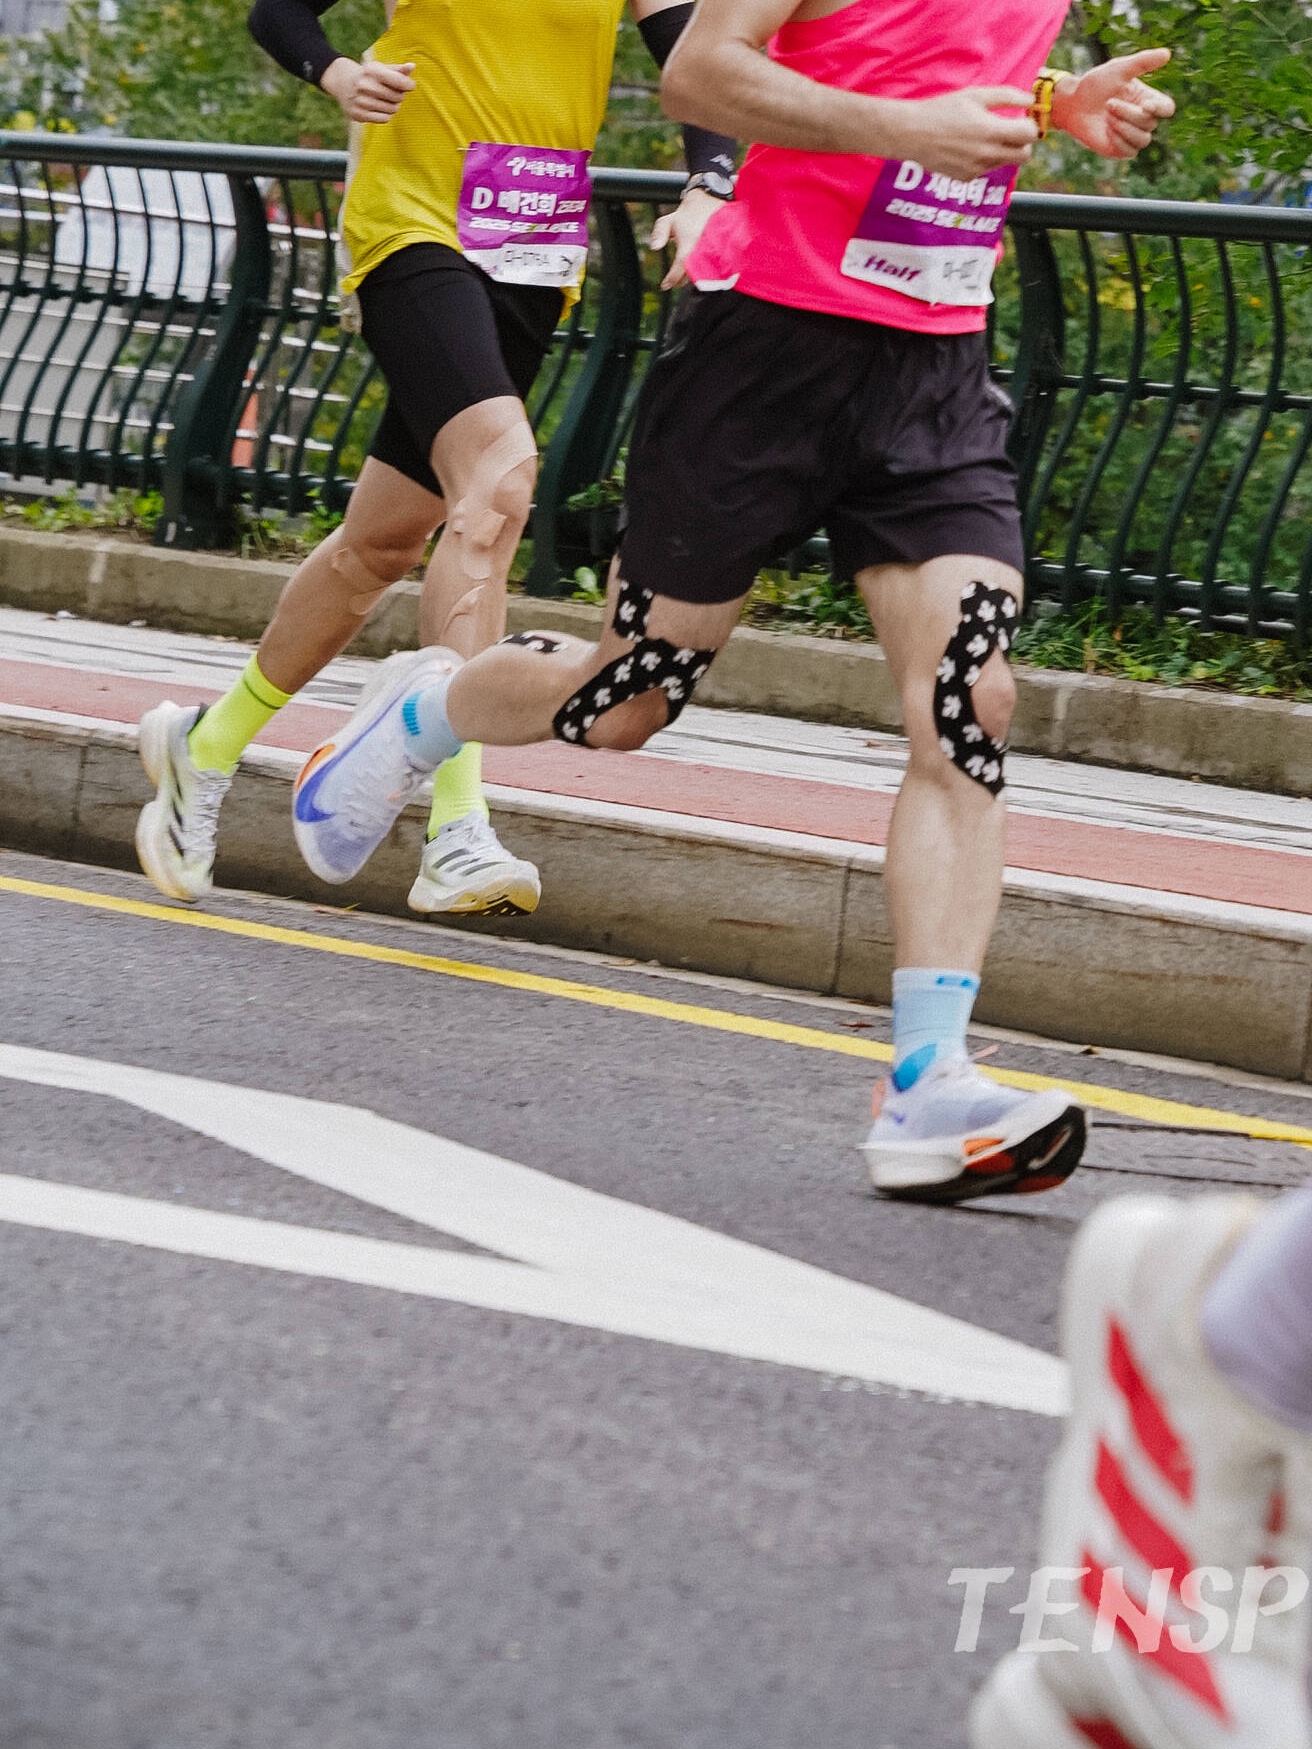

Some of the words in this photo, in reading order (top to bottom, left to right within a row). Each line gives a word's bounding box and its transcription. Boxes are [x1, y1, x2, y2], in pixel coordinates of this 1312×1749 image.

[892, 160, 925, 192] D
[471, 187, 494, 210] D
[885, 197, 939, 225] 2025
[468, 216, 512, 231] 2025
[863, 254, 923, 283] Half
